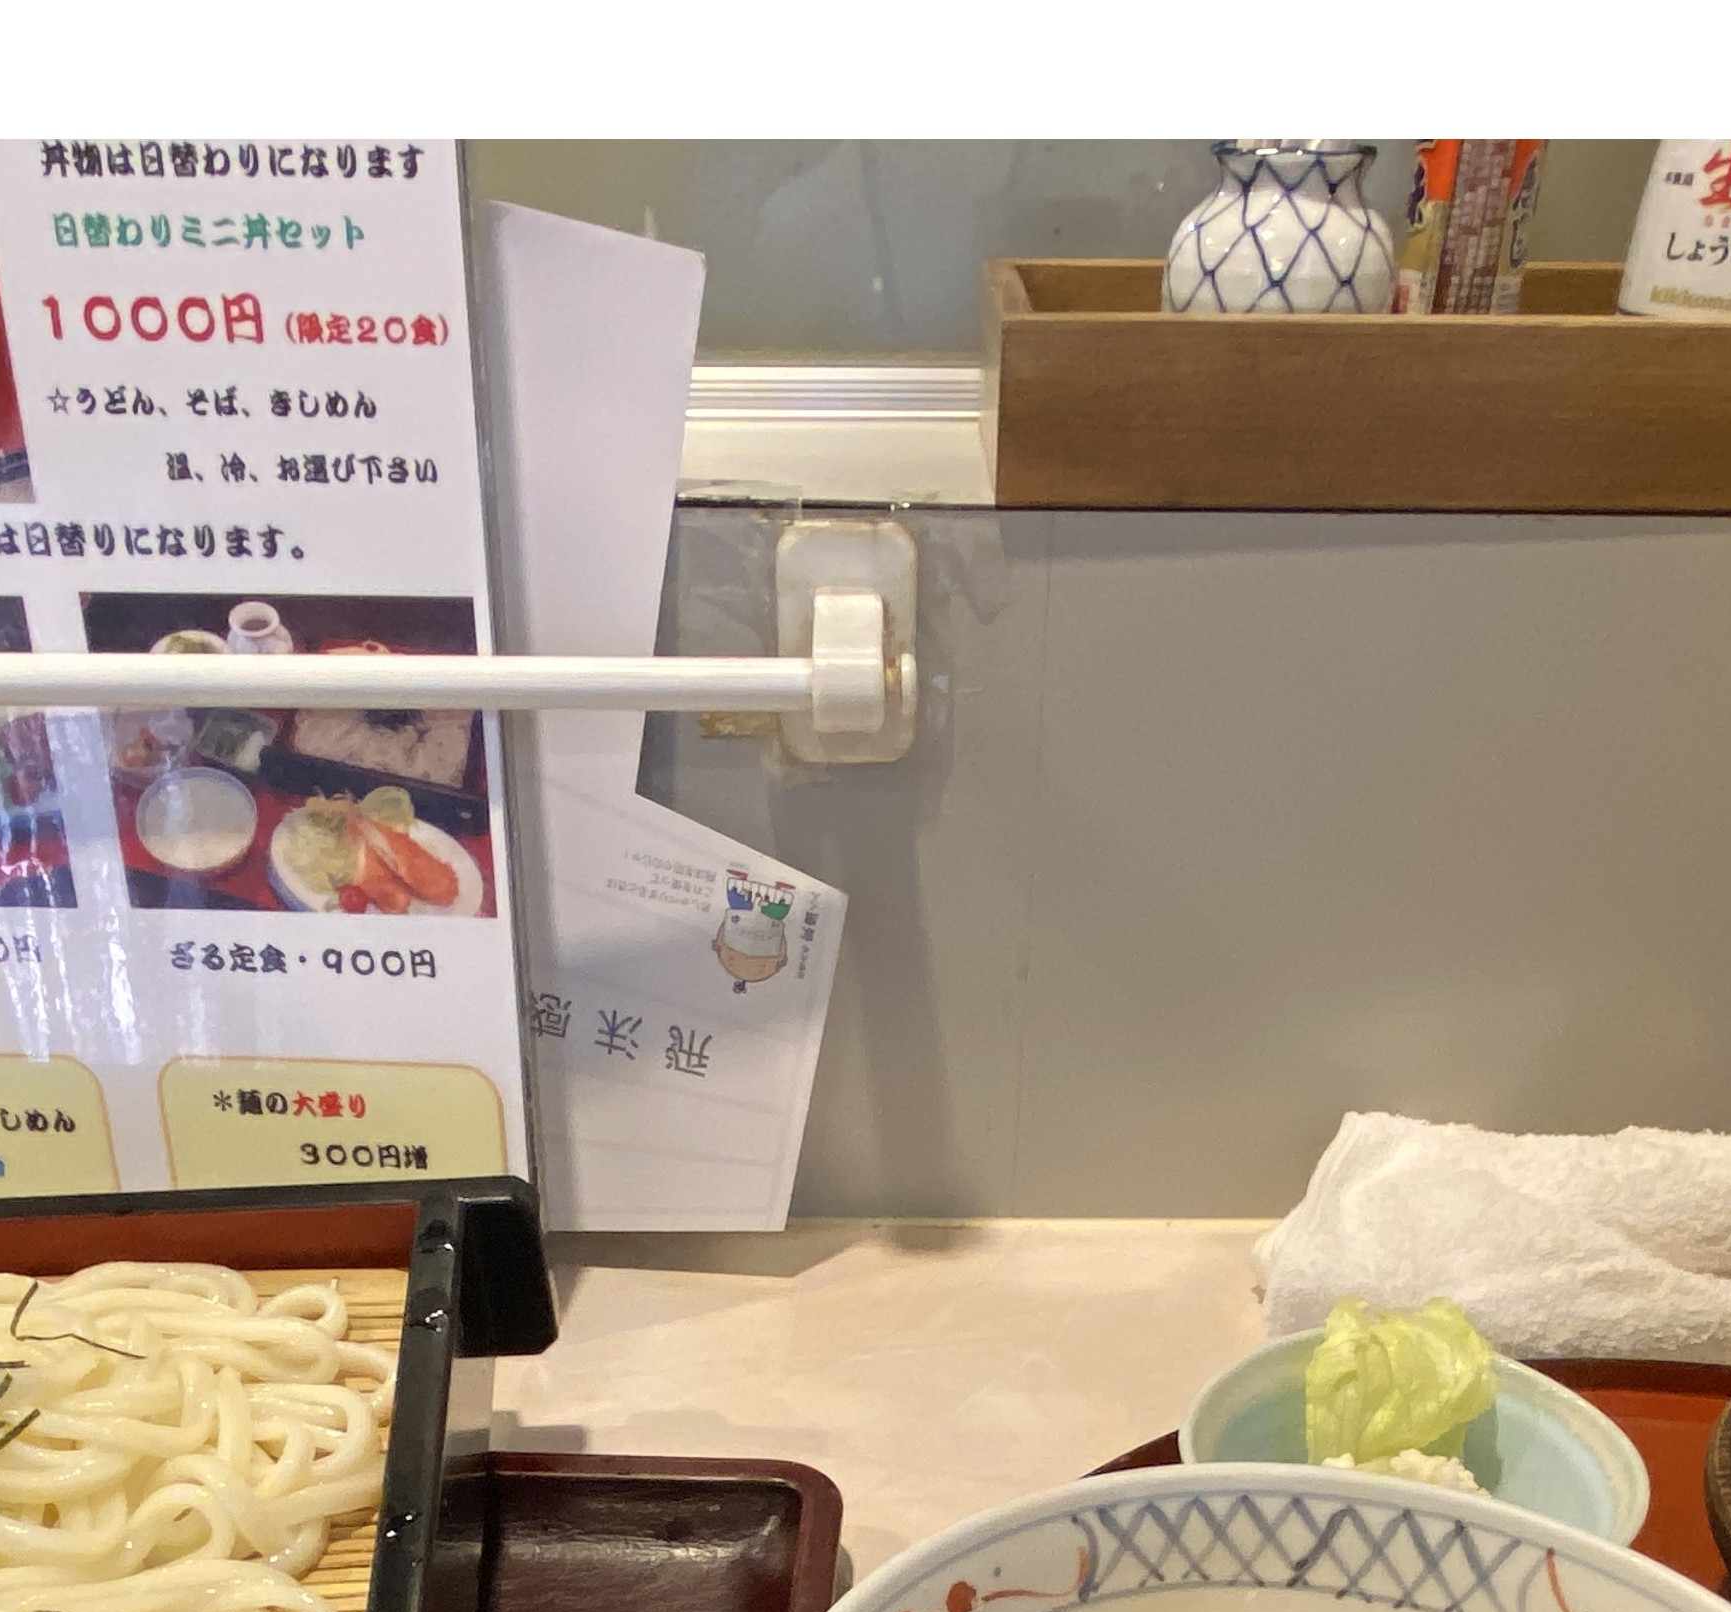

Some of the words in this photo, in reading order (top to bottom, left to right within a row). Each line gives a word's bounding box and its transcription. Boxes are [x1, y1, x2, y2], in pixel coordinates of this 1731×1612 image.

[41, 143, 424, 179] 丼物は日替わりになります
[53, 213, 365, 250] 日替わりミニ丼セット
[42, 292, 264, 344] 1000円
[300, 1142, 429, 1171] 300円増
